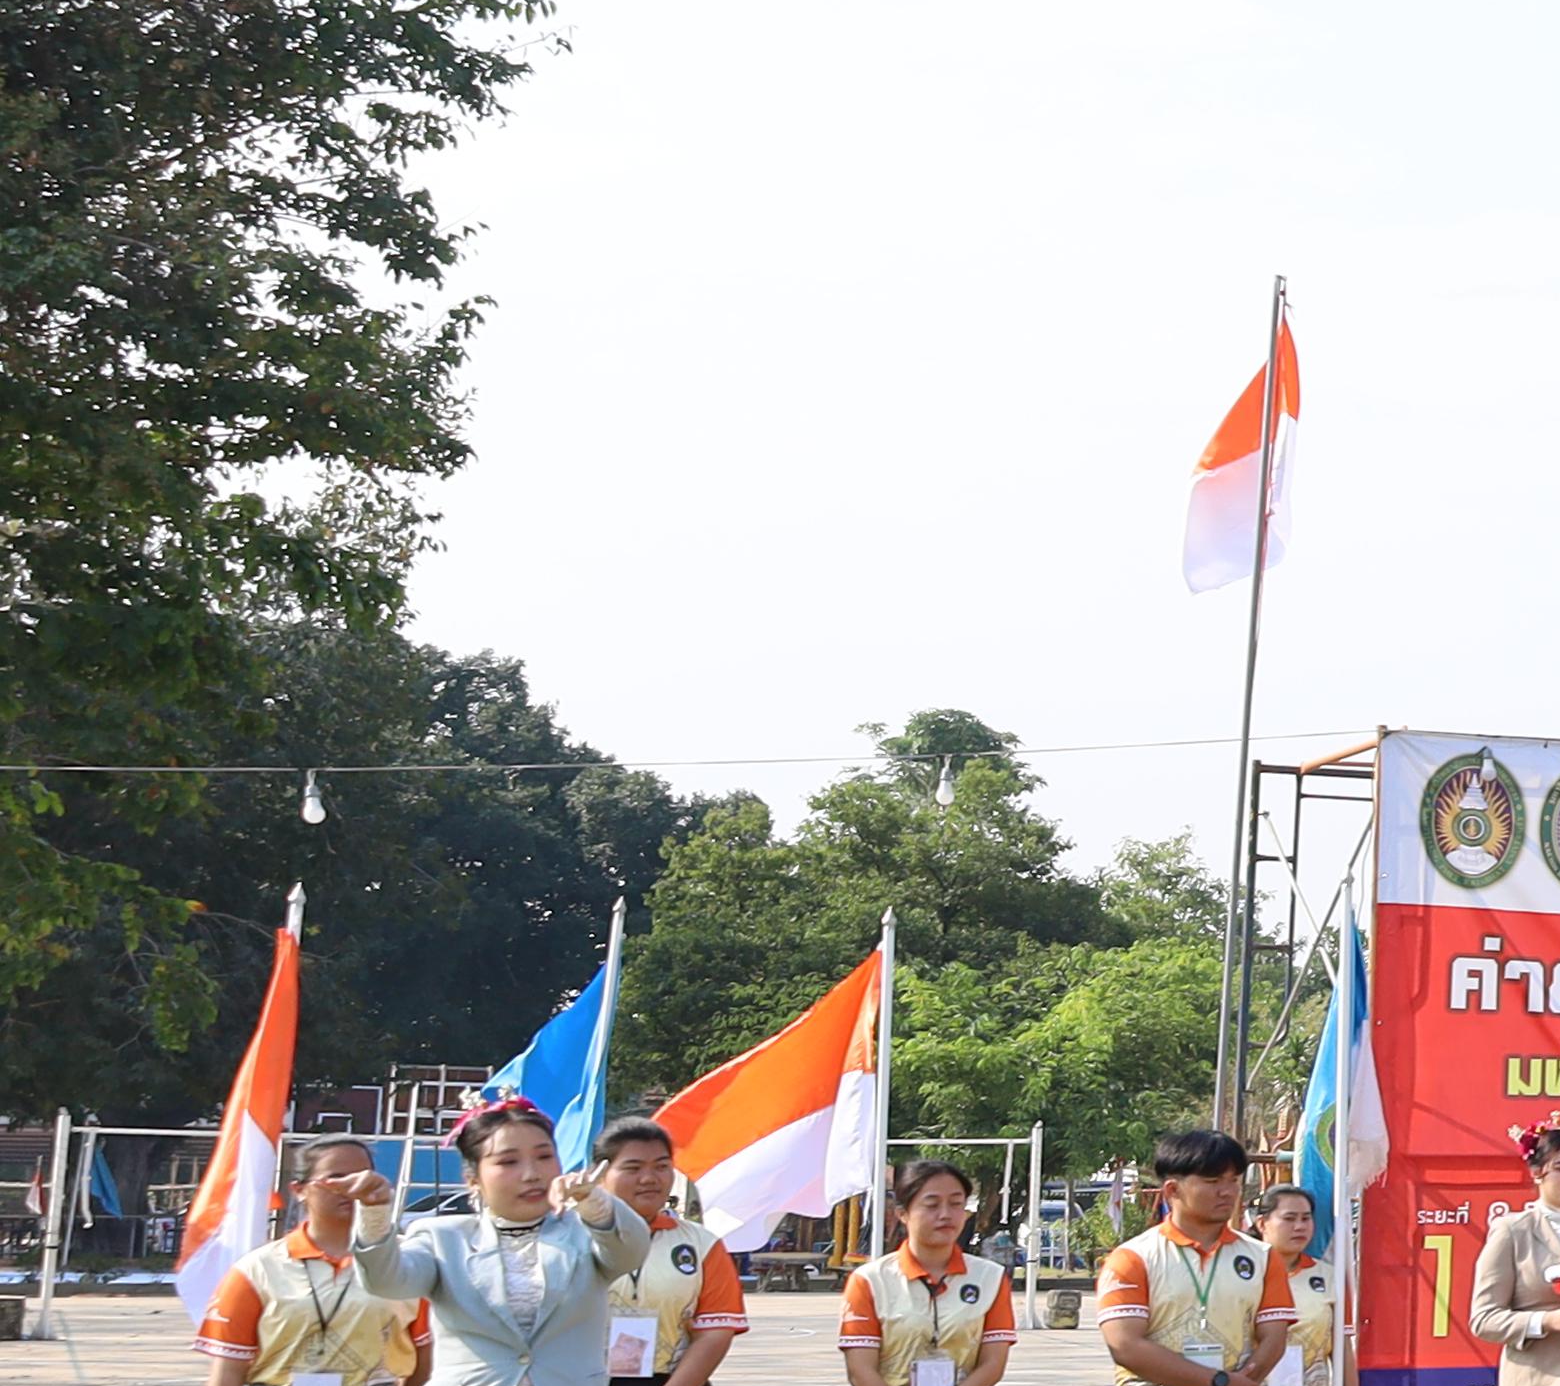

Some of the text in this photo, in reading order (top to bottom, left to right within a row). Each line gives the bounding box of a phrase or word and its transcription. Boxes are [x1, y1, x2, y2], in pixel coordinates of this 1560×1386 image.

[1417, 1201, 1470, 1225] ระยะที่
[1423, 1235, 1452, 1337] 1
